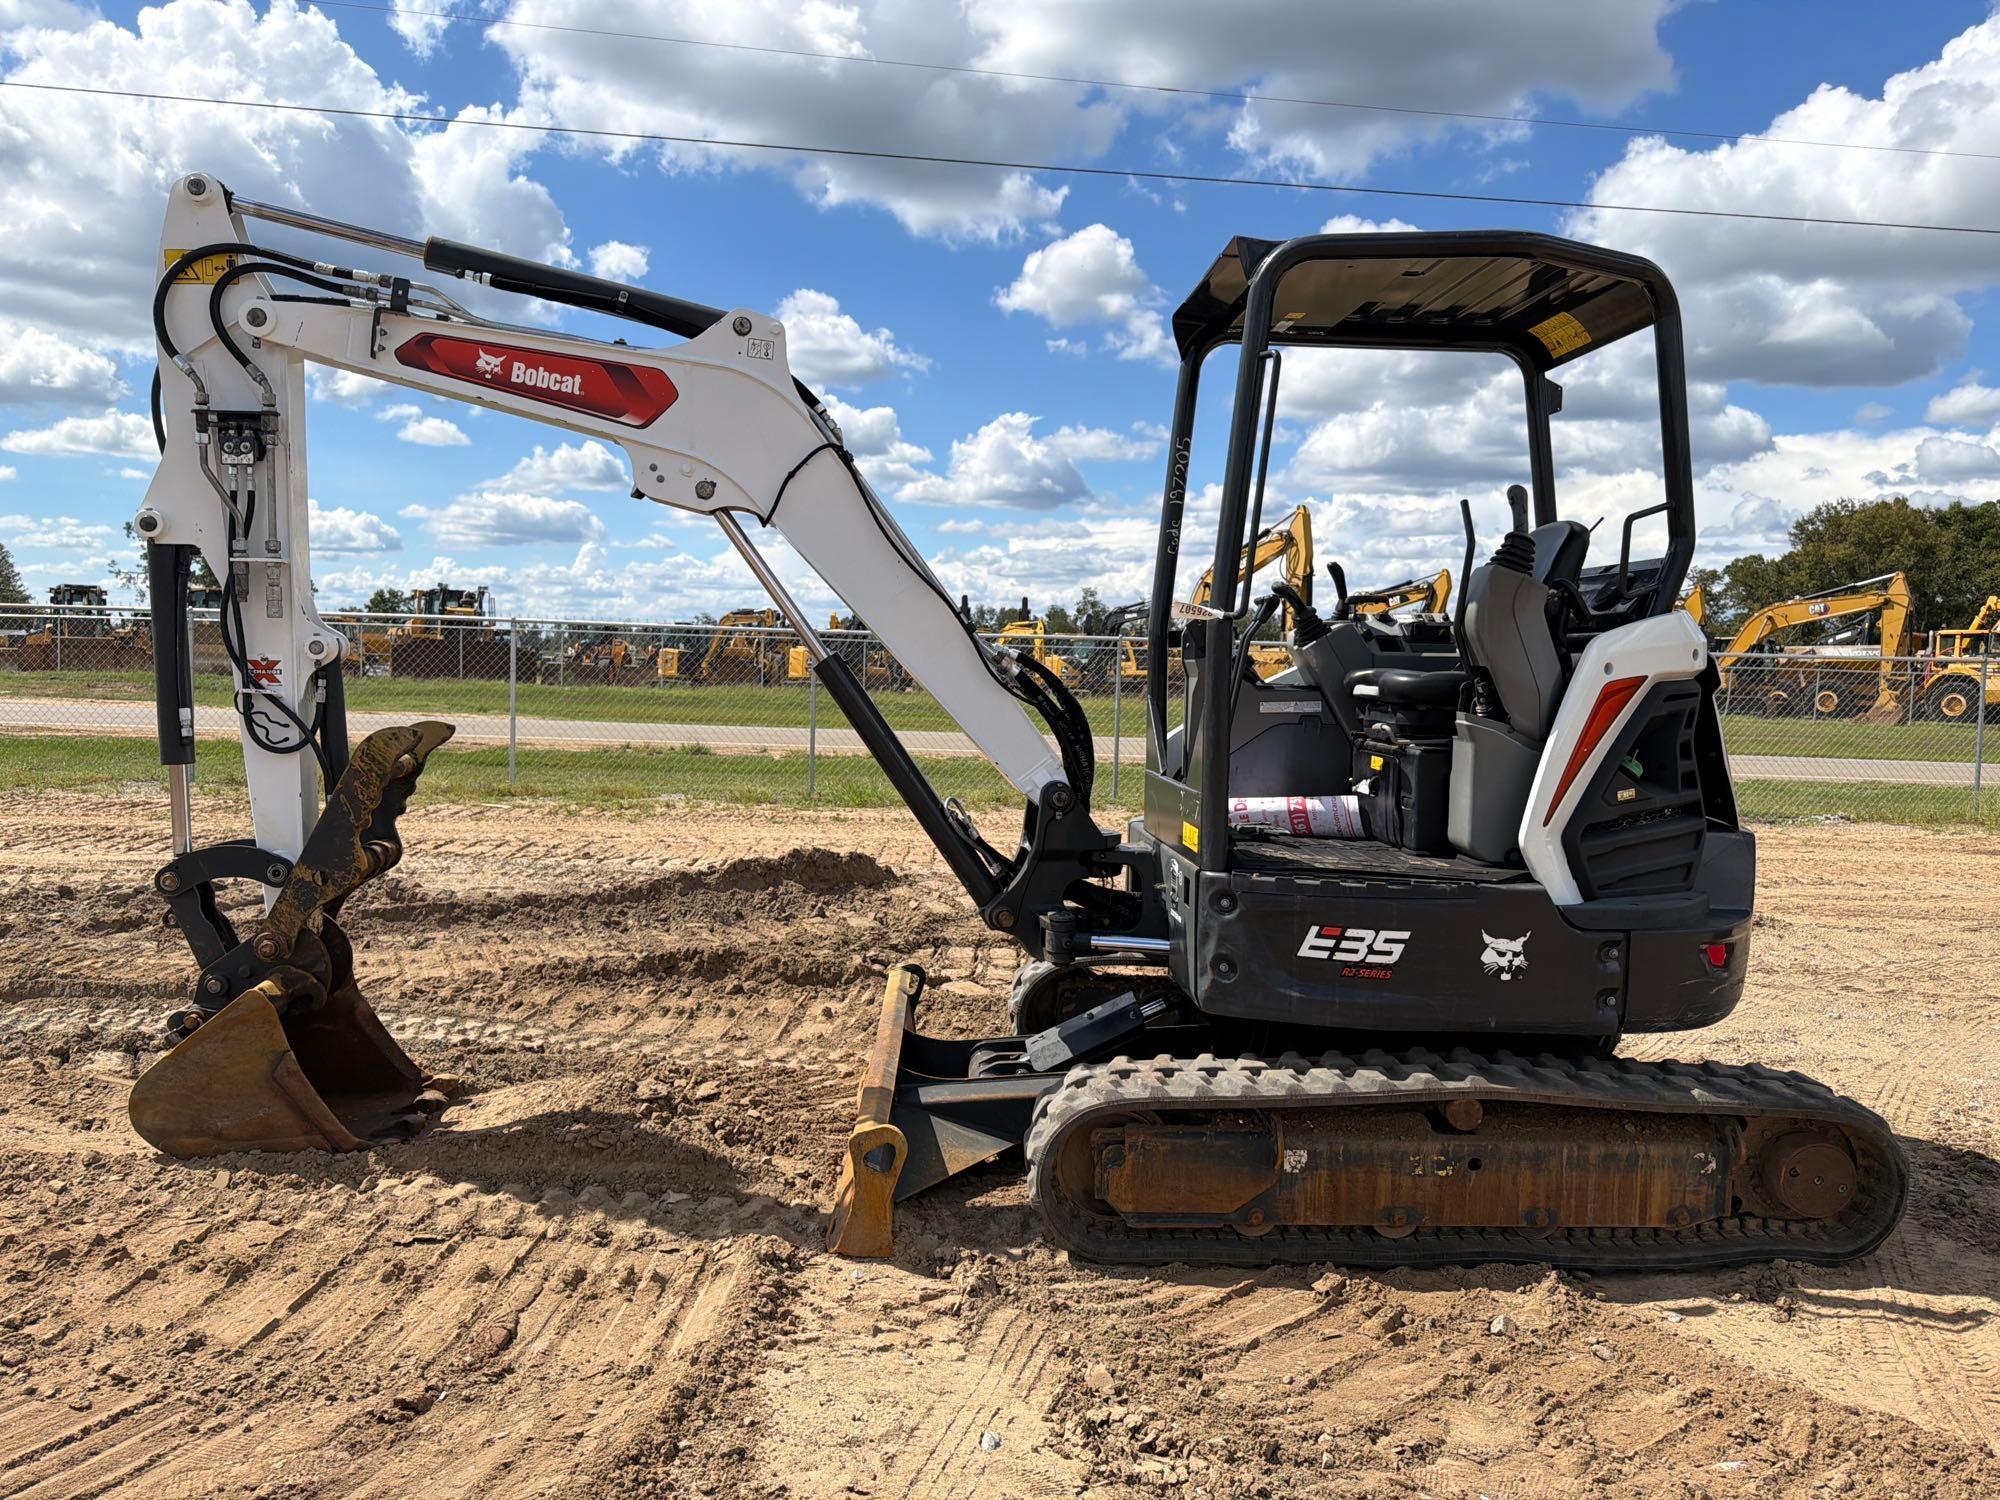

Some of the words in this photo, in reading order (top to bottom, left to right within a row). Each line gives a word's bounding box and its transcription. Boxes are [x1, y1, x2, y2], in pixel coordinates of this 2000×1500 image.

[511, 361, 582, 396] Bobcat
[1169, 436, 1191, 504] 197205
[1809, 603, 1825, 615] CAT
[1297, 925, 1411, 964] E35
[1341, 968, 1392, 979] R2-SERIES
